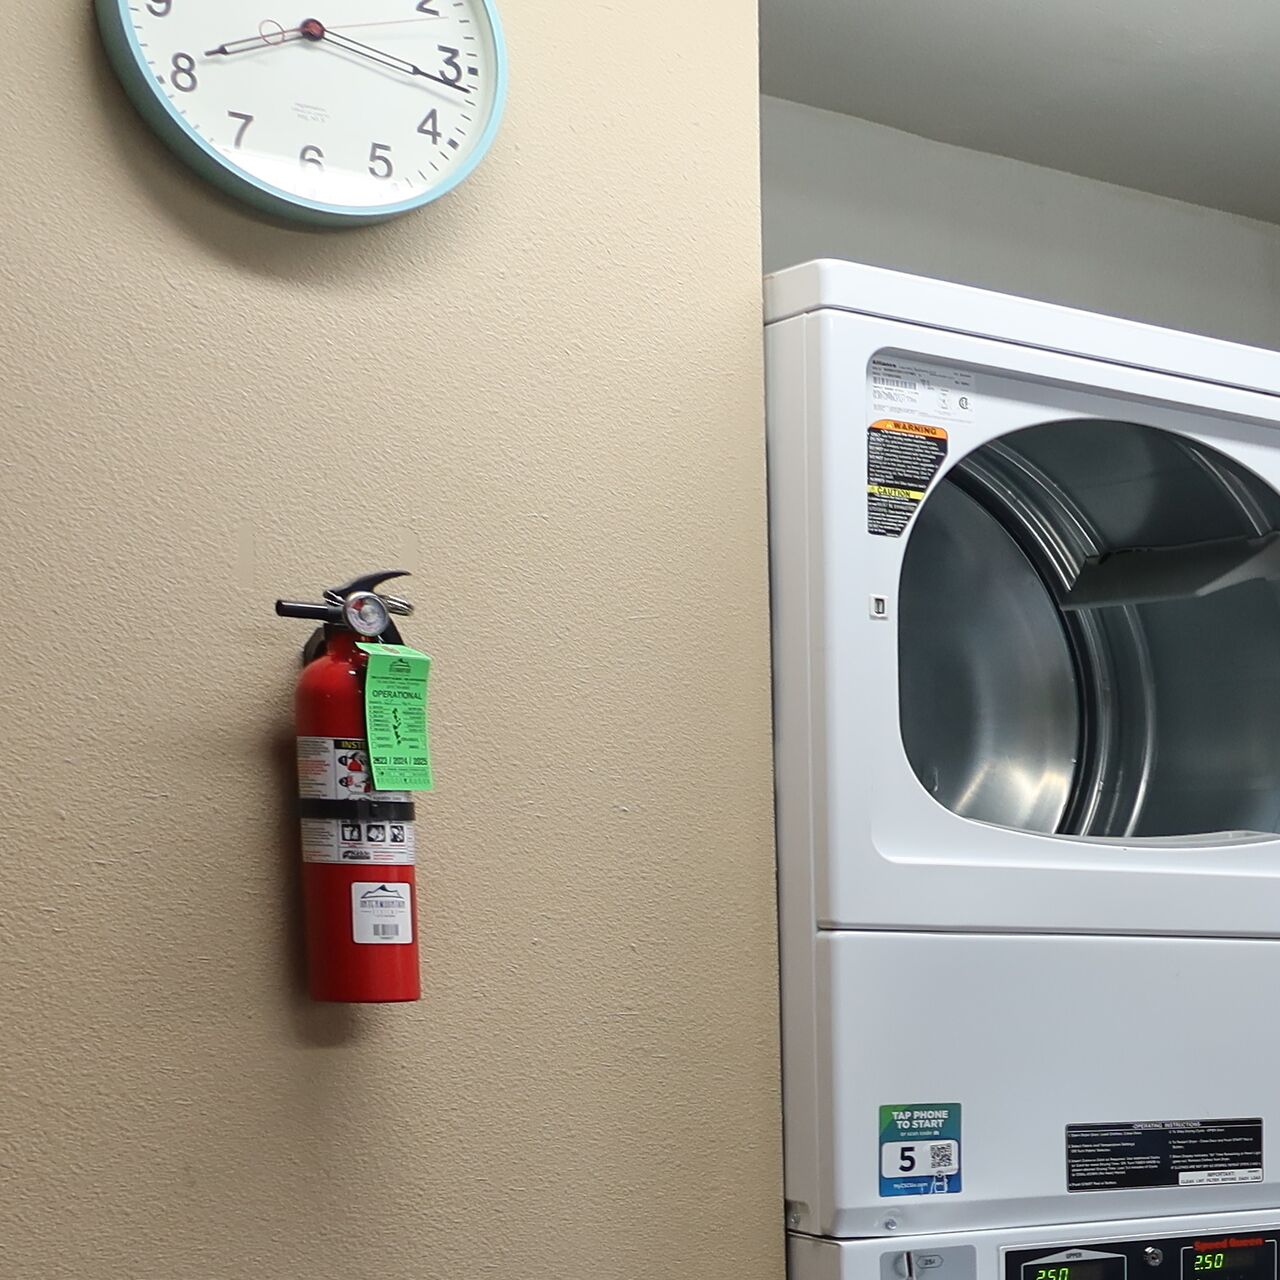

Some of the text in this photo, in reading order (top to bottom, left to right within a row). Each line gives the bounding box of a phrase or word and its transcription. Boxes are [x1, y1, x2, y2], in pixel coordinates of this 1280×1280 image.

[170, 53, 198, 93] 8
[437, 45, 463, 84] 3
[227, 111, 254, 148] 7
[416, 108, 442, 145] 4
[299, 145, 325, 174] 6
[368, 142, 393, 179] 5
[893, 423, 937, 435] WARNING
[877, 486, 911, 498] CAUTION
[372, 690, 422, 700] OPERATIONAL
[896, 1120, 944, 1129] TO START
[914, 1110, 949, 1119] PHONE
[899, 1146, 916, 1172] 5
